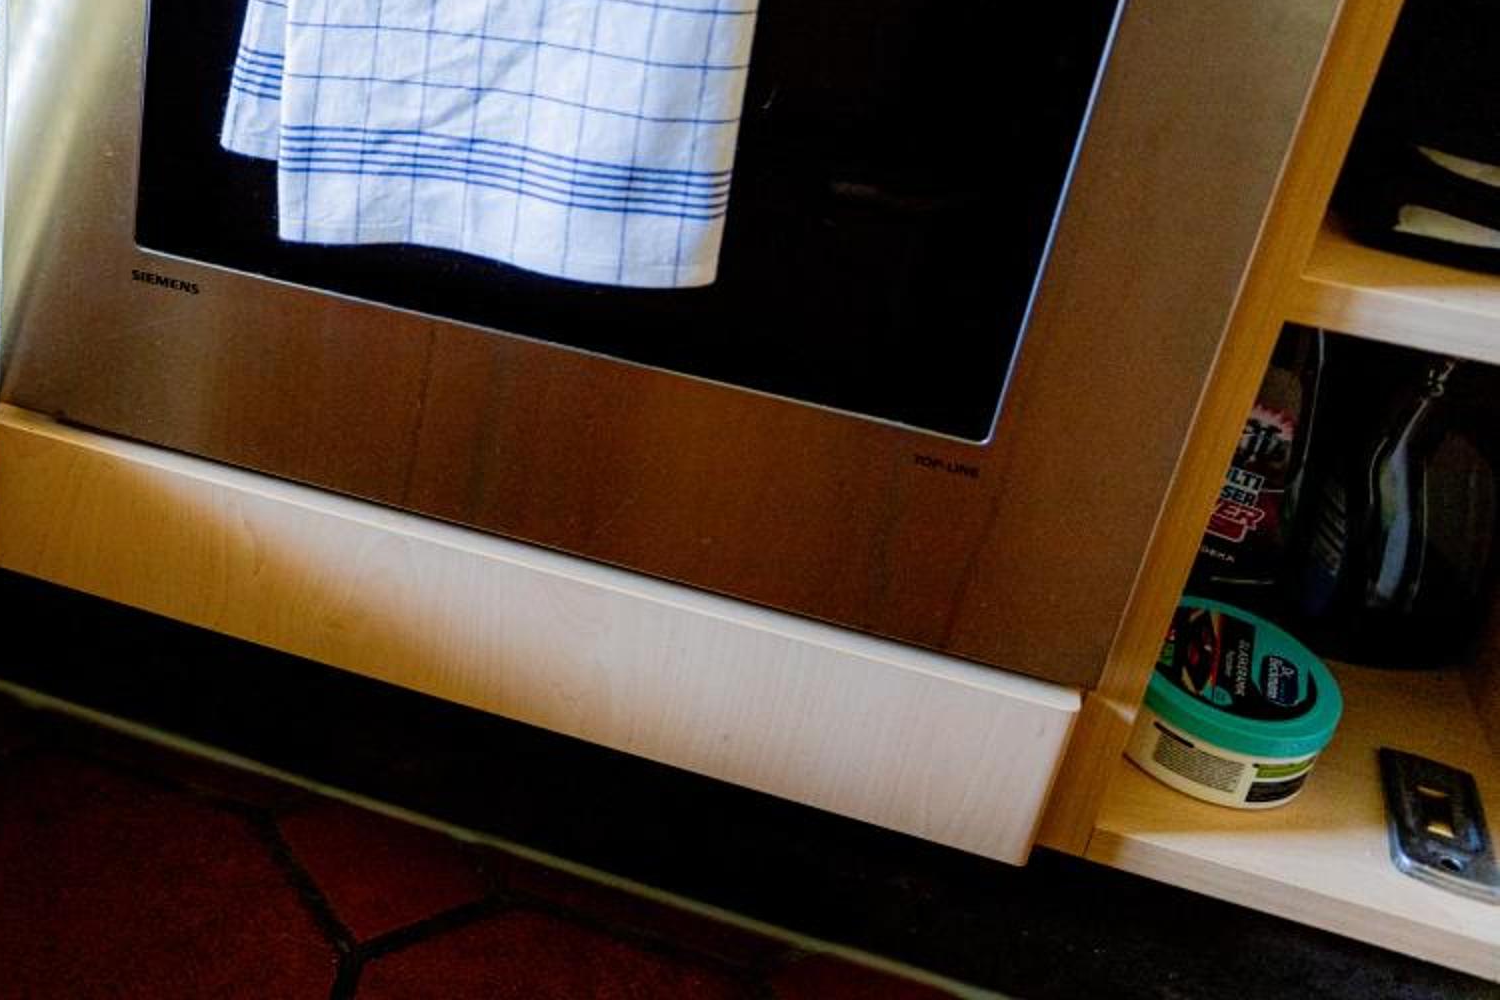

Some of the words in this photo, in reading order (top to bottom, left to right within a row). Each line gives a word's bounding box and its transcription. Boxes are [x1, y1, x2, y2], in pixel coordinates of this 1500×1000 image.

[131, 269, 200, 295] SIEMENS
[1225, 466, 1263, 491] LTI
[1220, 485, 1257, 507] SER
